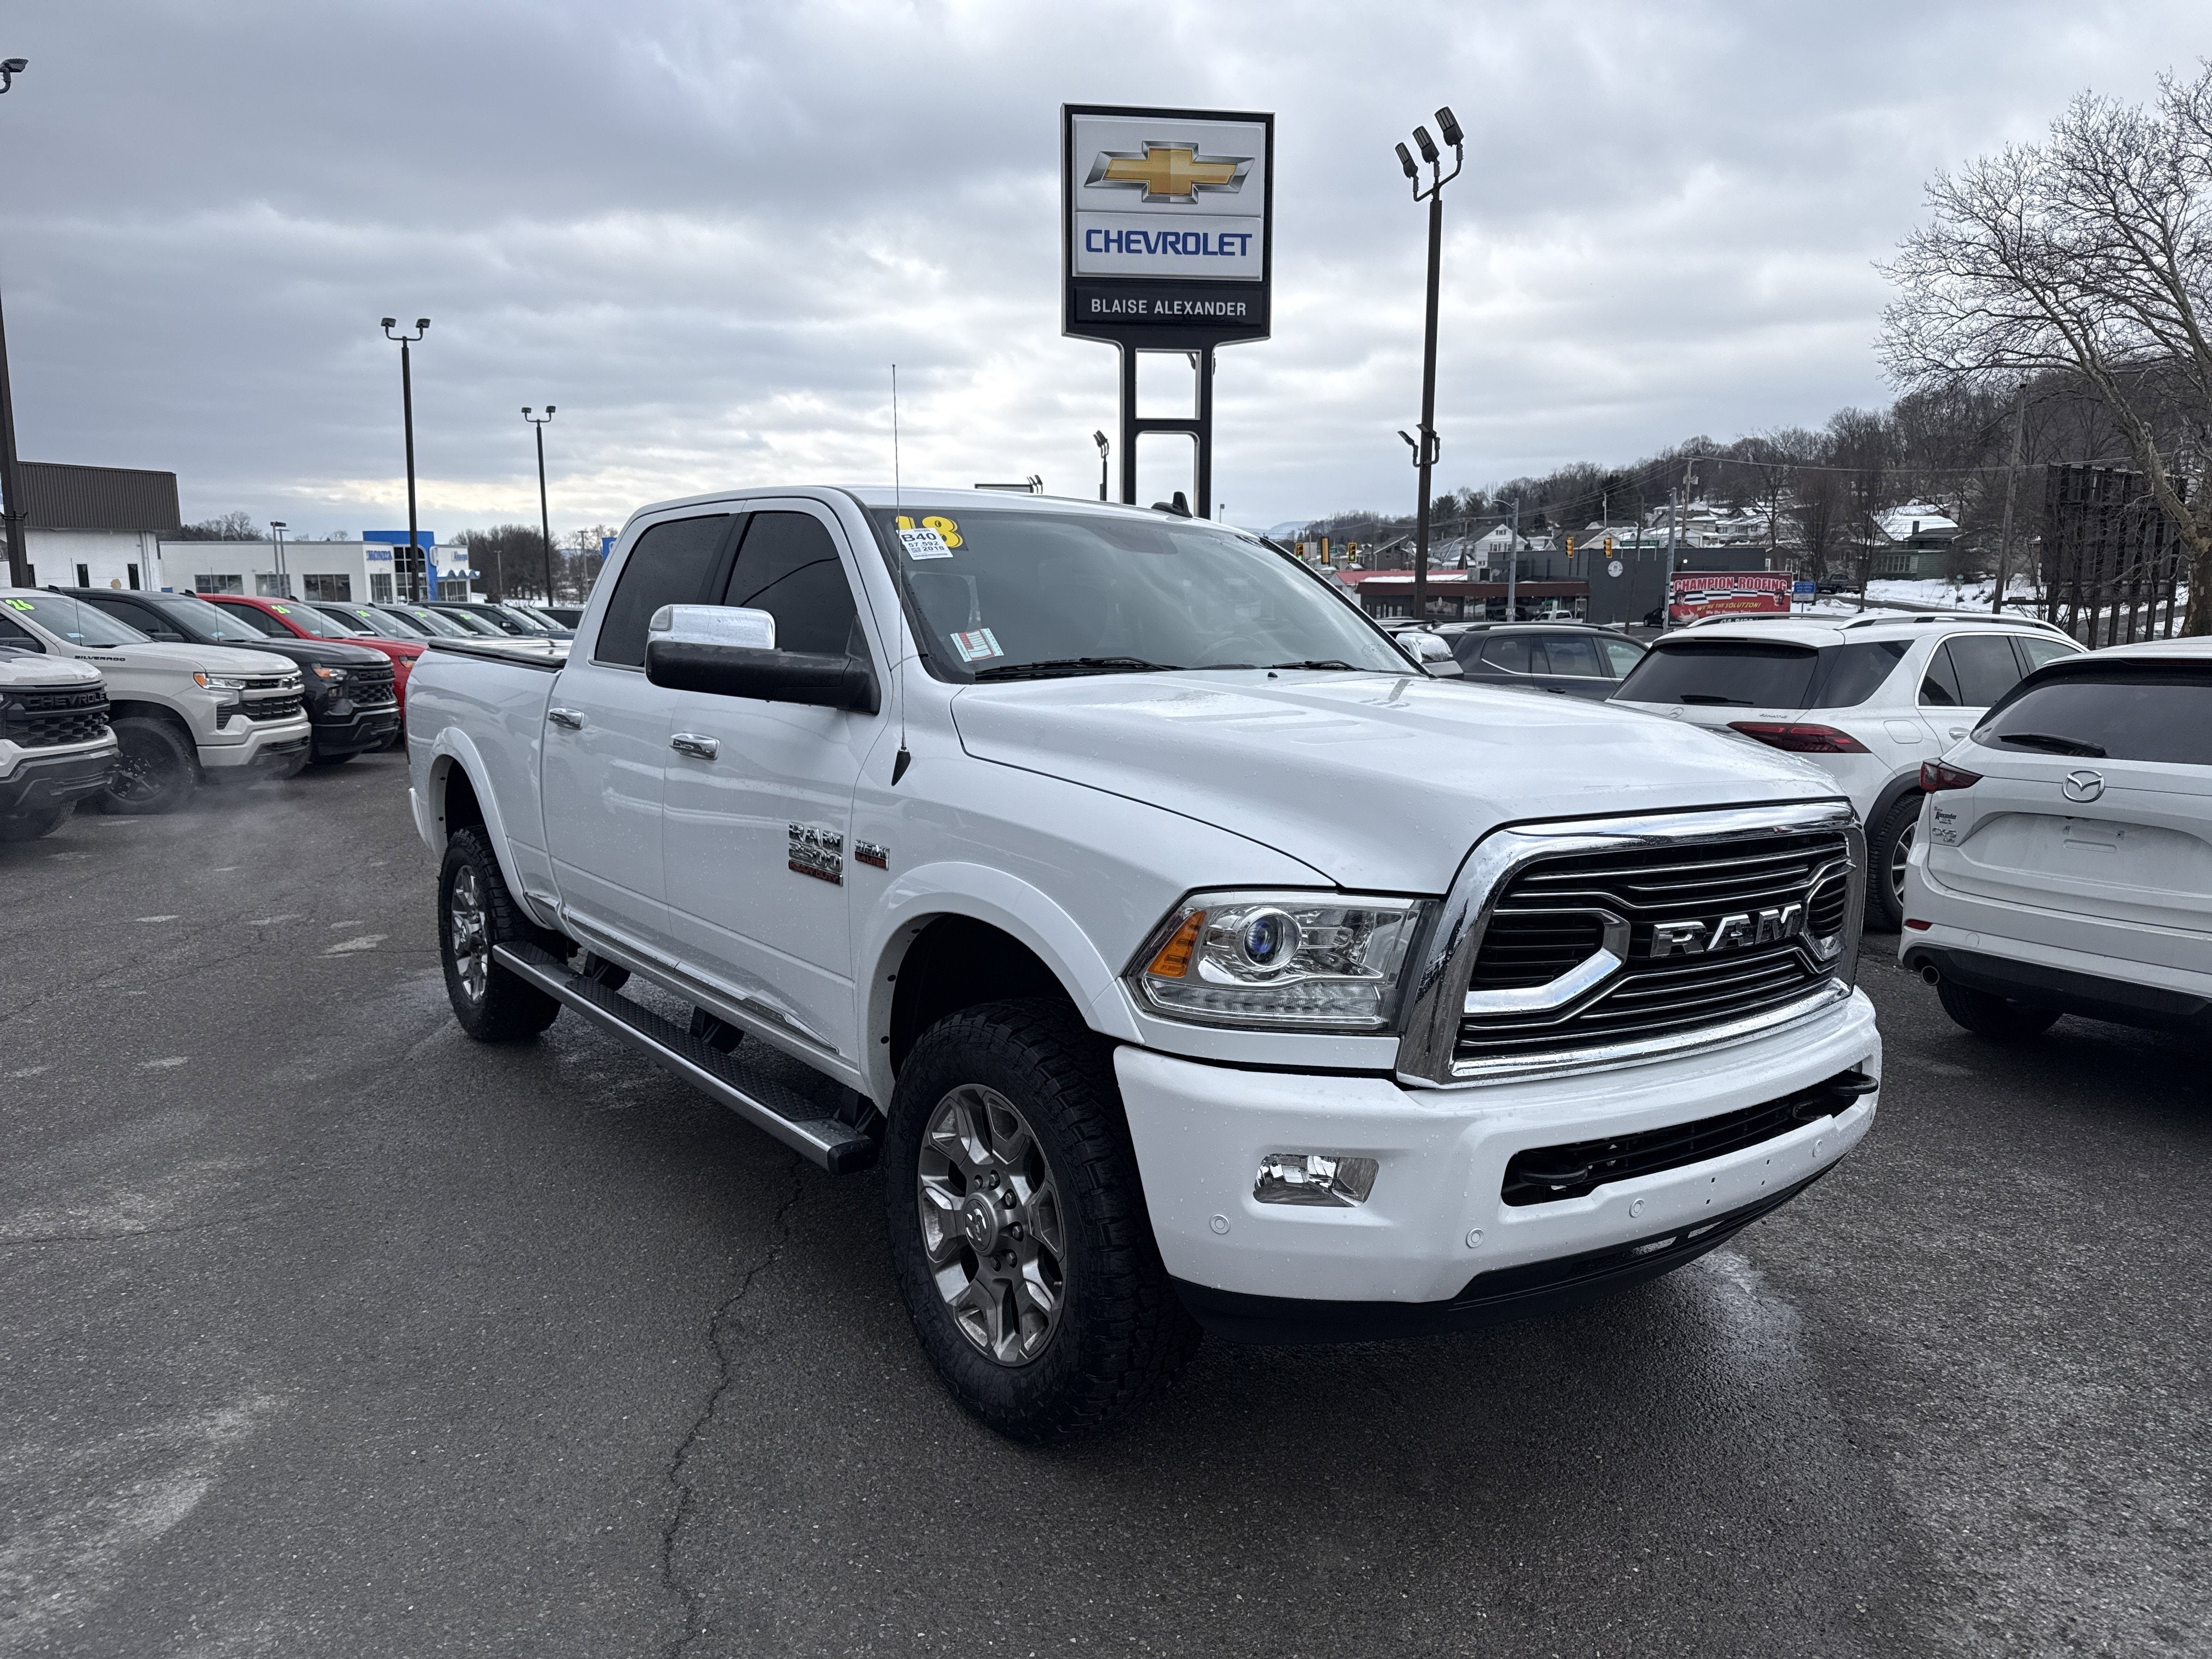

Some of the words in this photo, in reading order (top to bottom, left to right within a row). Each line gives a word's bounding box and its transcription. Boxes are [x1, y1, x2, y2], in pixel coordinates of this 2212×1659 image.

[1086, 229, 1252, 256] CHEVROLET
[1091, 298, 1147, 314] BLAISE
[1154, 300, 1246, 316] ALEXANDER
[901, 533, 936, 541] B40
[1673, 577, 1734, 593] CHAMPION
[1737, 576, 1787, 592] ROOFING
[5, 599, 35, 611] 26
[28, 691, 106, 707] CHEVROLE
[789, 822, 843, 853] RAM
[1932, 827, 1957, 838] CX-5
[789, 841, 843, 872] 2500
[855, 839, 890, 860] HEMI
[815, 869, 839, 883] DUTY
[1650, 903, 1801, 958] RAM
